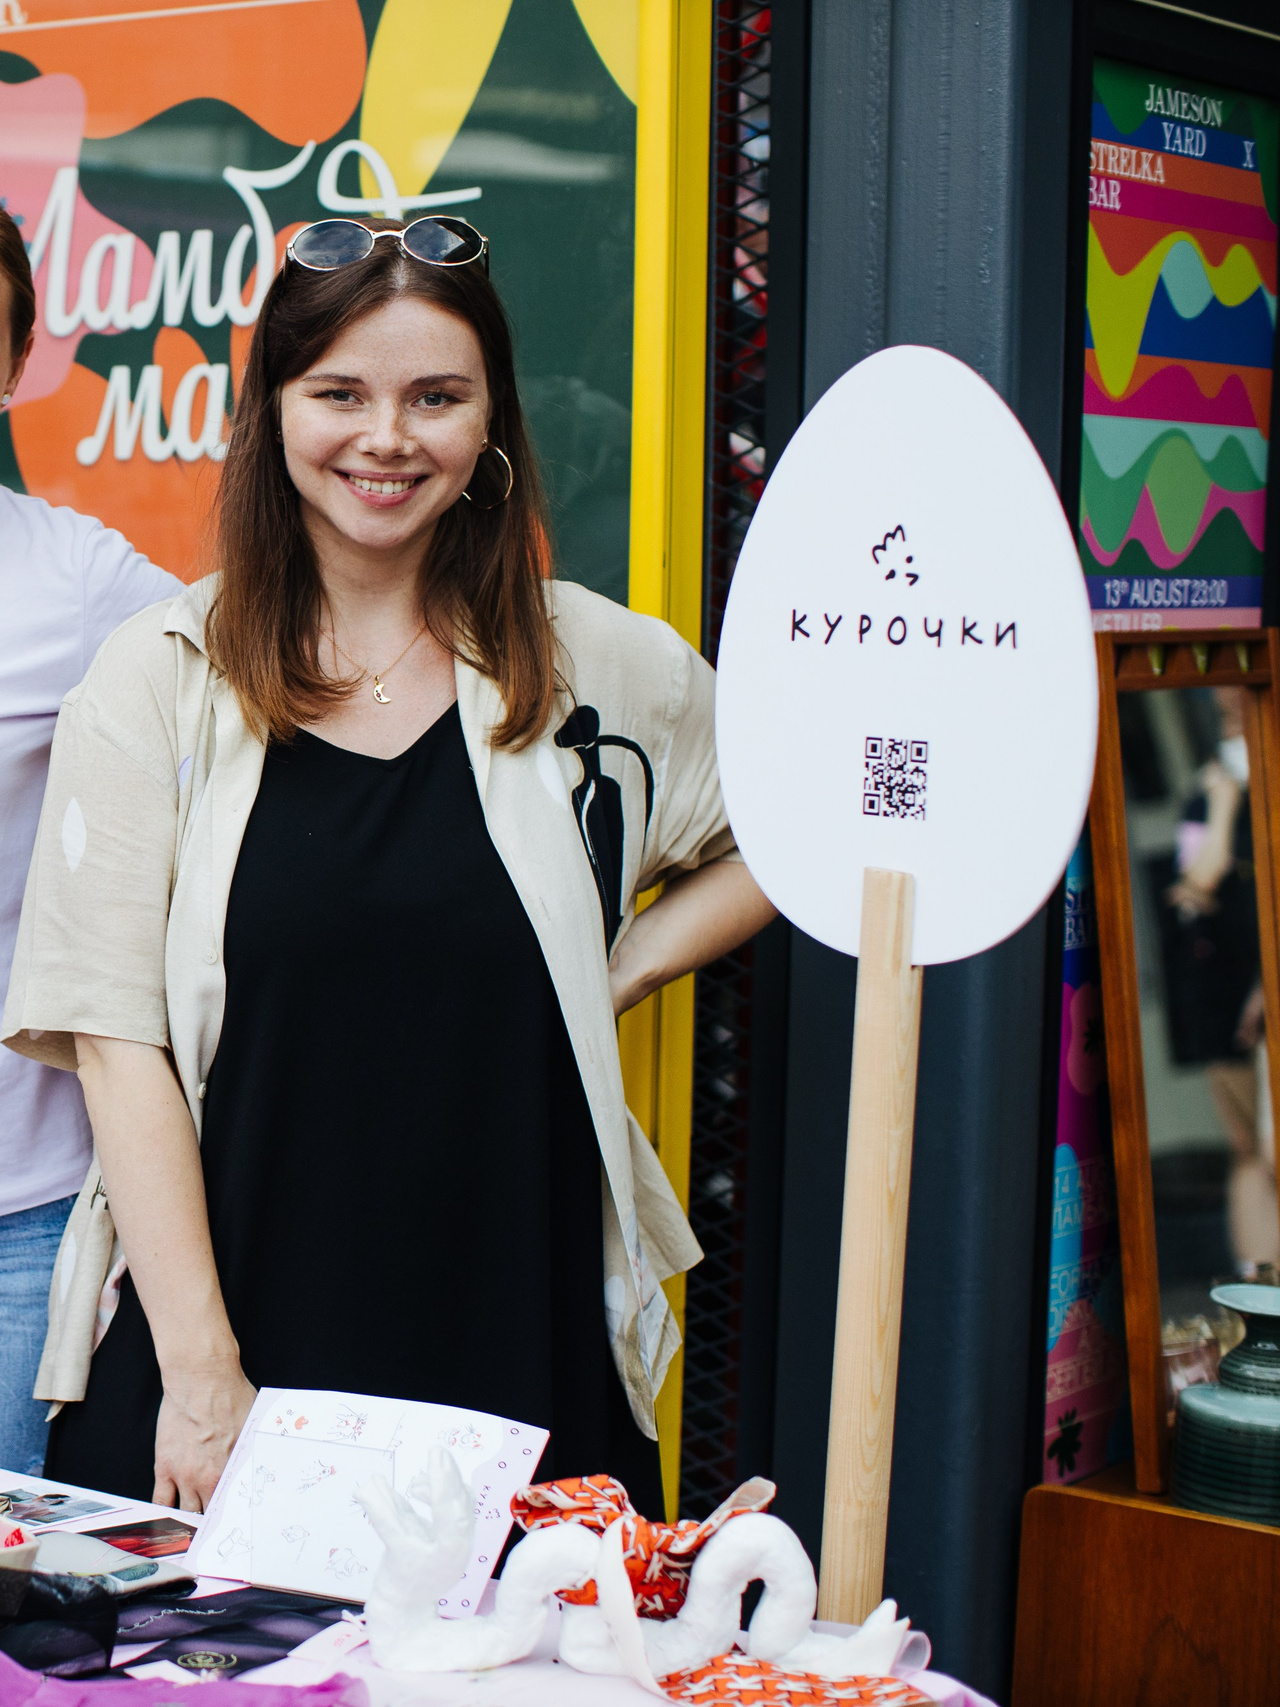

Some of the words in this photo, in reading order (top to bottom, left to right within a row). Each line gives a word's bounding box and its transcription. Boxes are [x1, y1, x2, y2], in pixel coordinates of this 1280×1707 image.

[1146, 83, 1223, 127] JAMESON
[1090, 141, 1166, 183] STRELKA
[1162, 121, 1207, 158] YARD
[1242, 140, 1256, 169] X
[1130, 578, 1191, 608] AUGUST
[790, 608, 1017, 650] КУРОЧКИ
